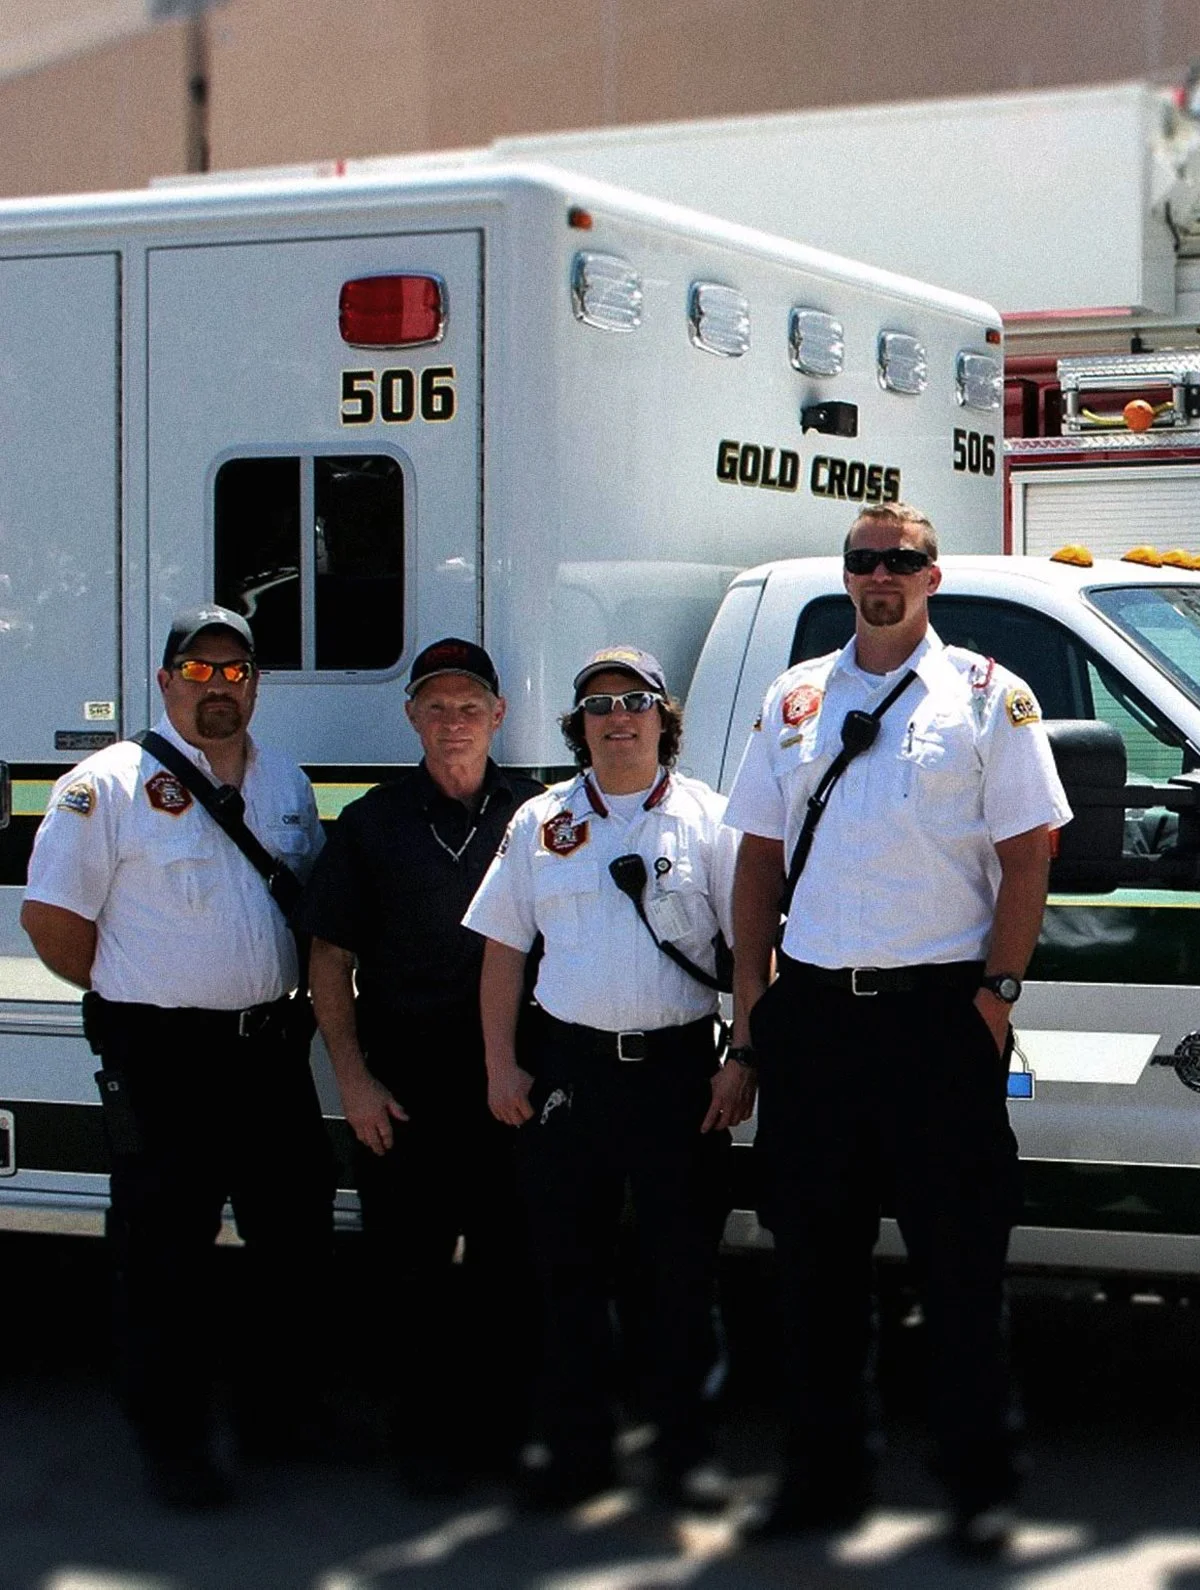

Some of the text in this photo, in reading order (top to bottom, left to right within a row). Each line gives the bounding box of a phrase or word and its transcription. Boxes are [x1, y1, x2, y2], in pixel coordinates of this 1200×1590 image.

[340, 364, 457, 427] 506
[716, 438, 901, 504] GOLD CROSS
[953, 427, 996, 476] 506
